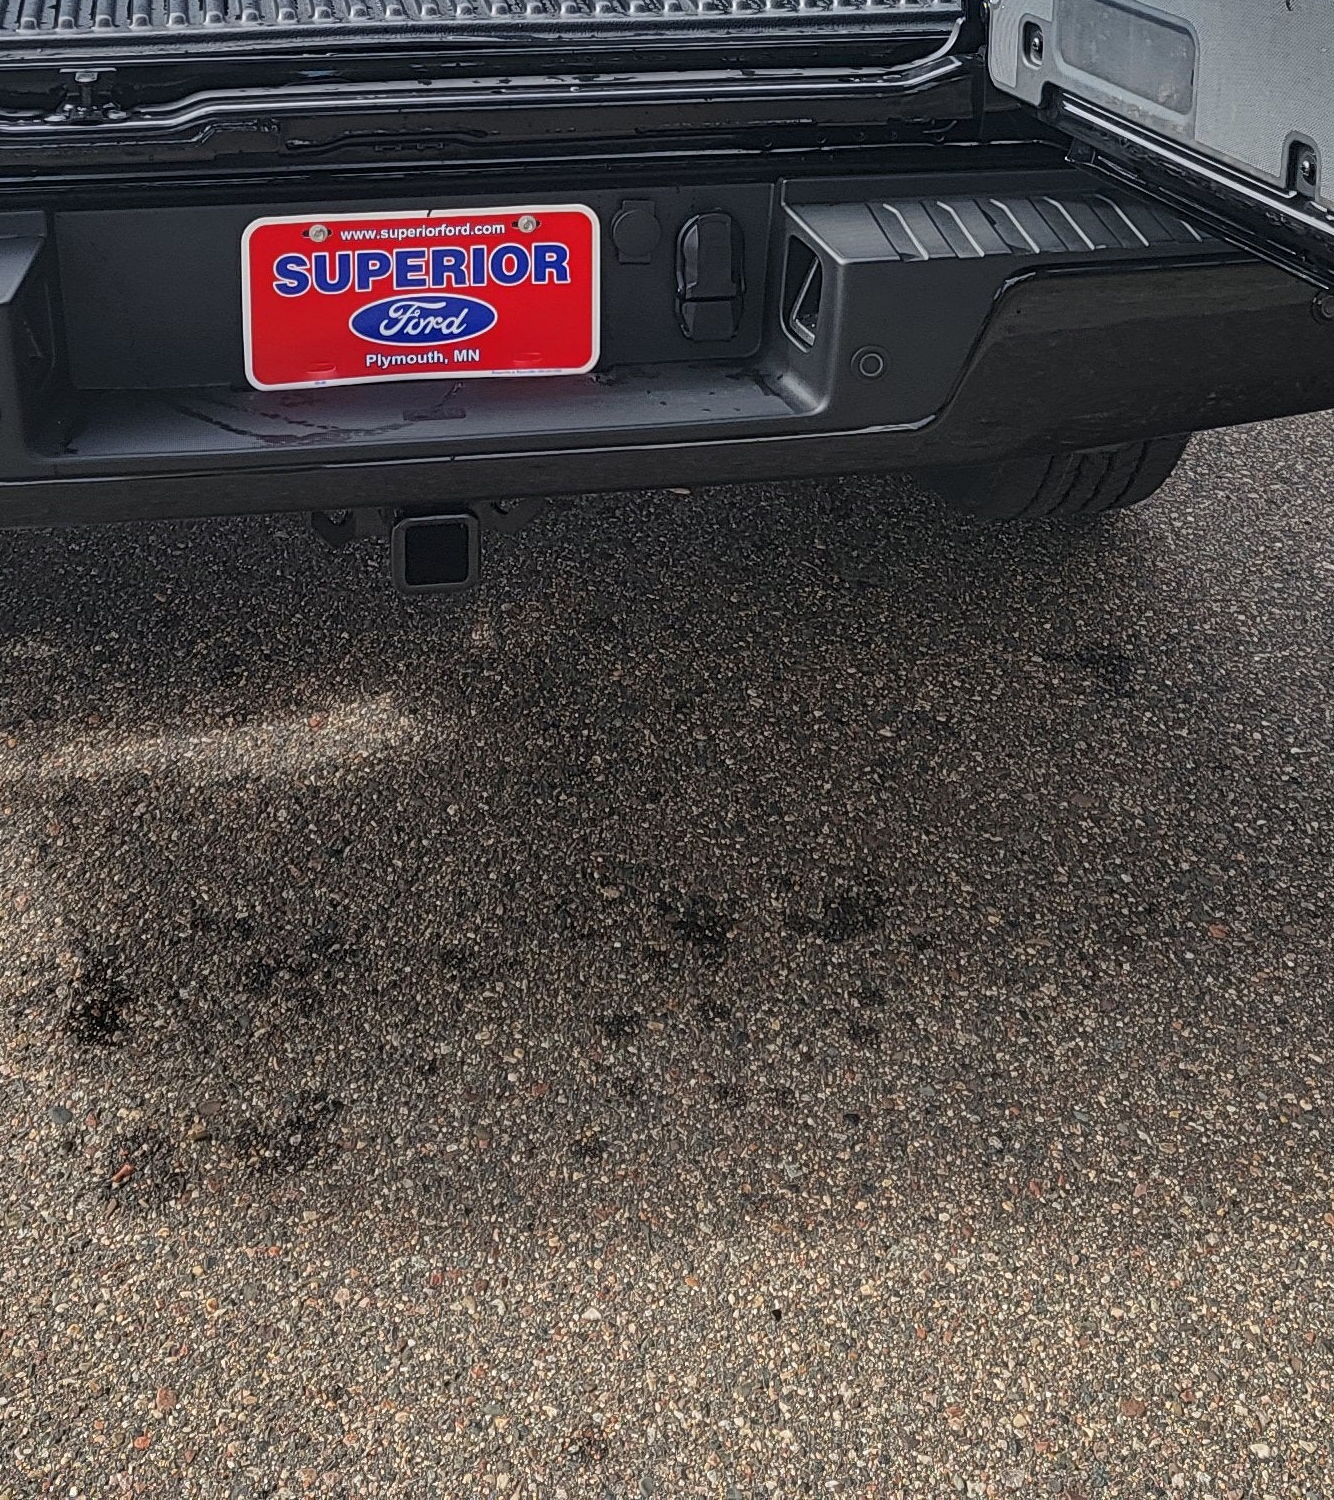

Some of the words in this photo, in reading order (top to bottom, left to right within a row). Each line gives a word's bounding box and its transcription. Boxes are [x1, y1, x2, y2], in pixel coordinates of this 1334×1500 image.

[340, 222, 505, 241] www.superiorford.com
[273, 242, 571, 298] SUPERIOR
[378, 301, 469, 337] Ford
[365, 351, 449, 368] Plymouth,
[453, 349, 480, 363] MN
